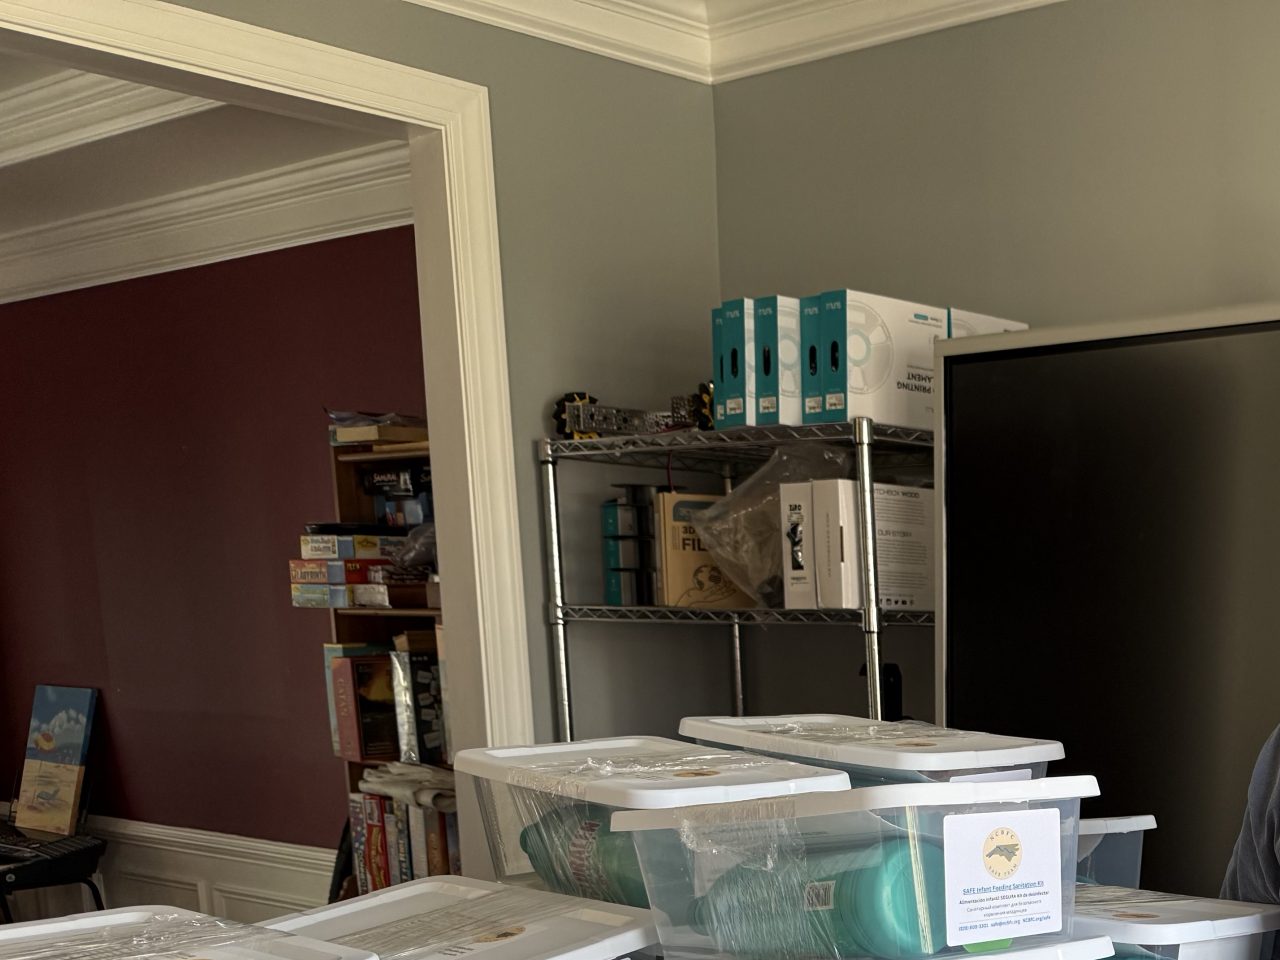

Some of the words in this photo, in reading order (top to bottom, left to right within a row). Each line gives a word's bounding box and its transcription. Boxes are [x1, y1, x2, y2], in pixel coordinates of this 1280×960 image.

[897, 381, 931, 394] PRINTING
[682, 526, 695, 535] 3D
[993, 884, 1011, 892] Feeding
[1013, 881, 1036, 890] Sanitation
